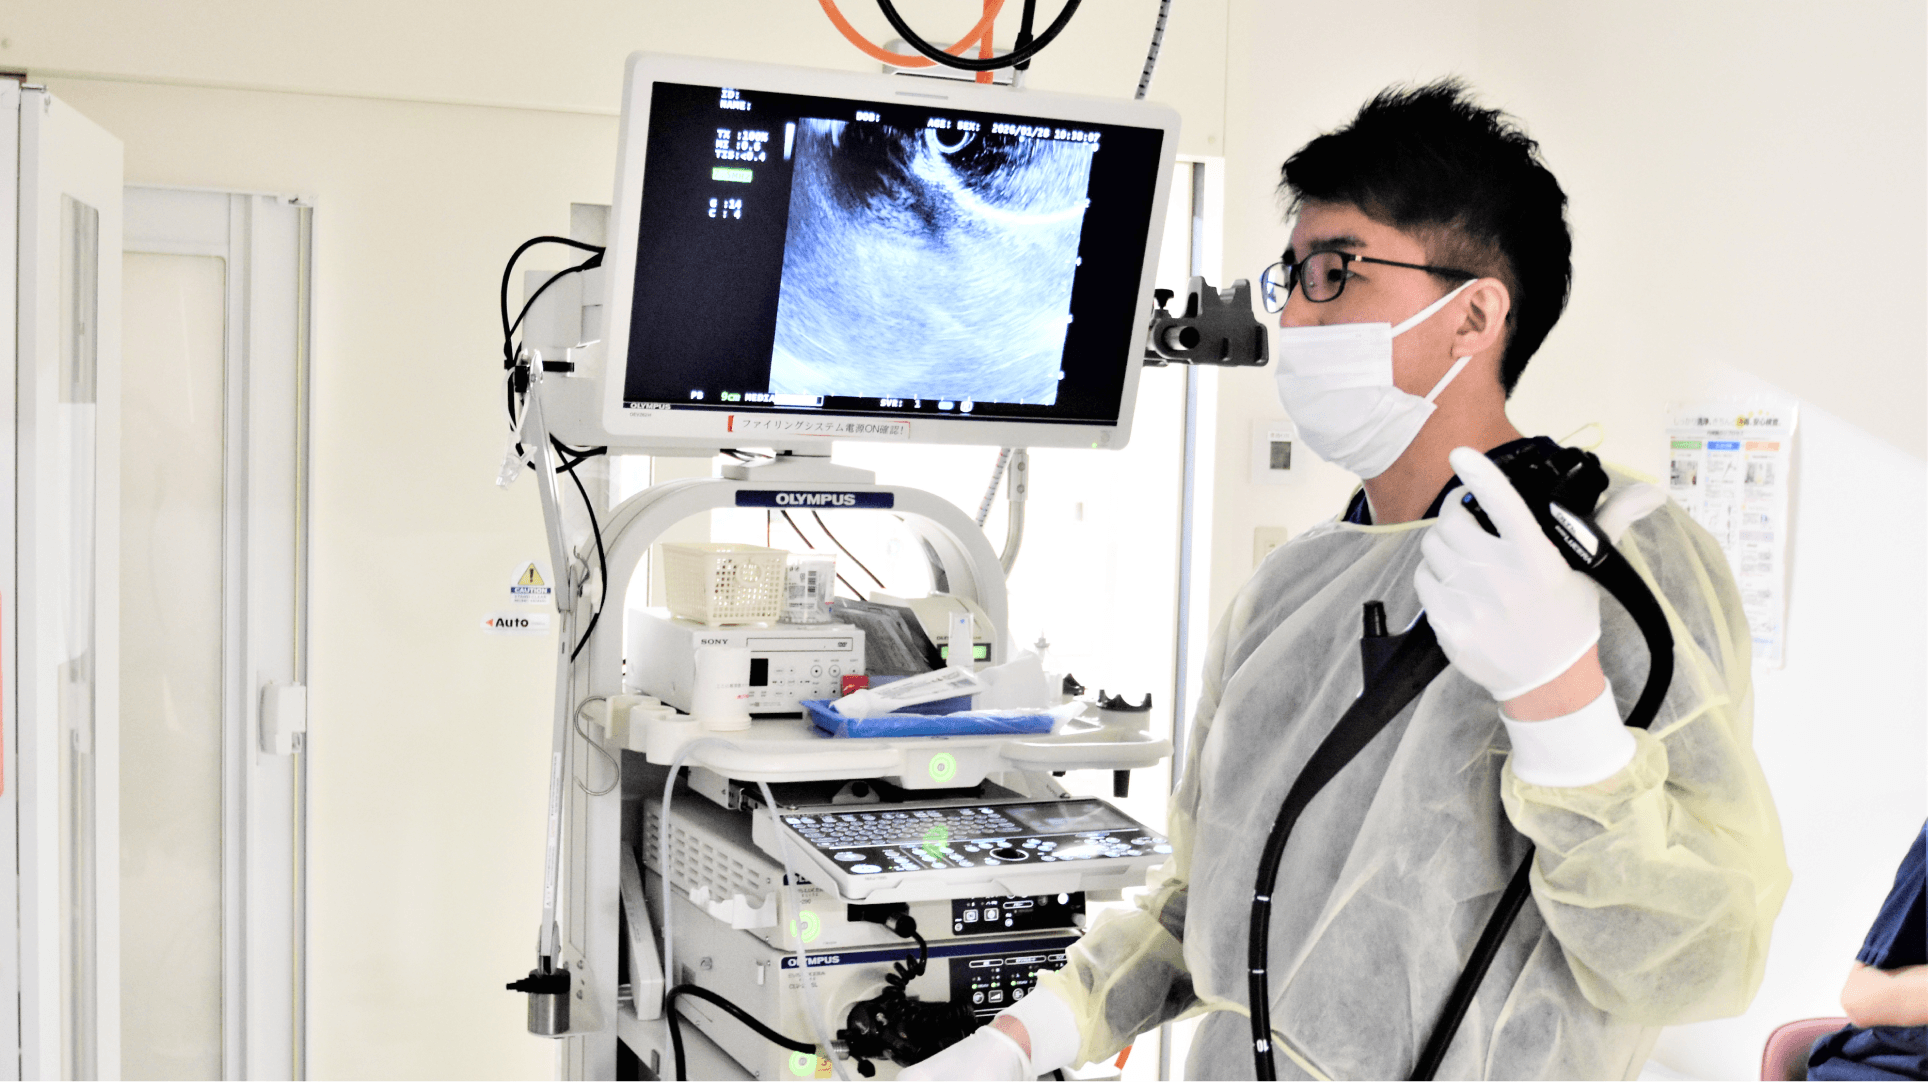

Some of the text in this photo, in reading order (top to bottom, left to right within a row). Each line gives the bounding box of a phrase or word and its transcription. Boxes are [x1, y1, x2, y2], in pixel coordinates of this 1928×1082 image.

[721, 88, 740, 100] ID:
[719, 99, 752, 111] NAME:
[855, 110, 880, 123] DOB:
[926, 117, 981, 132] AGE: SEX:
[629, 402, 671, 411] OLYMPUS
[775, 492, 856, 507] OLYMPUS
[513, 587, 548, 595] CAUTION
[495, 617, 529, 628] Auto
[701, 638, 729, 646] SONY
[1256, 1038, 1270, 1053] 10
